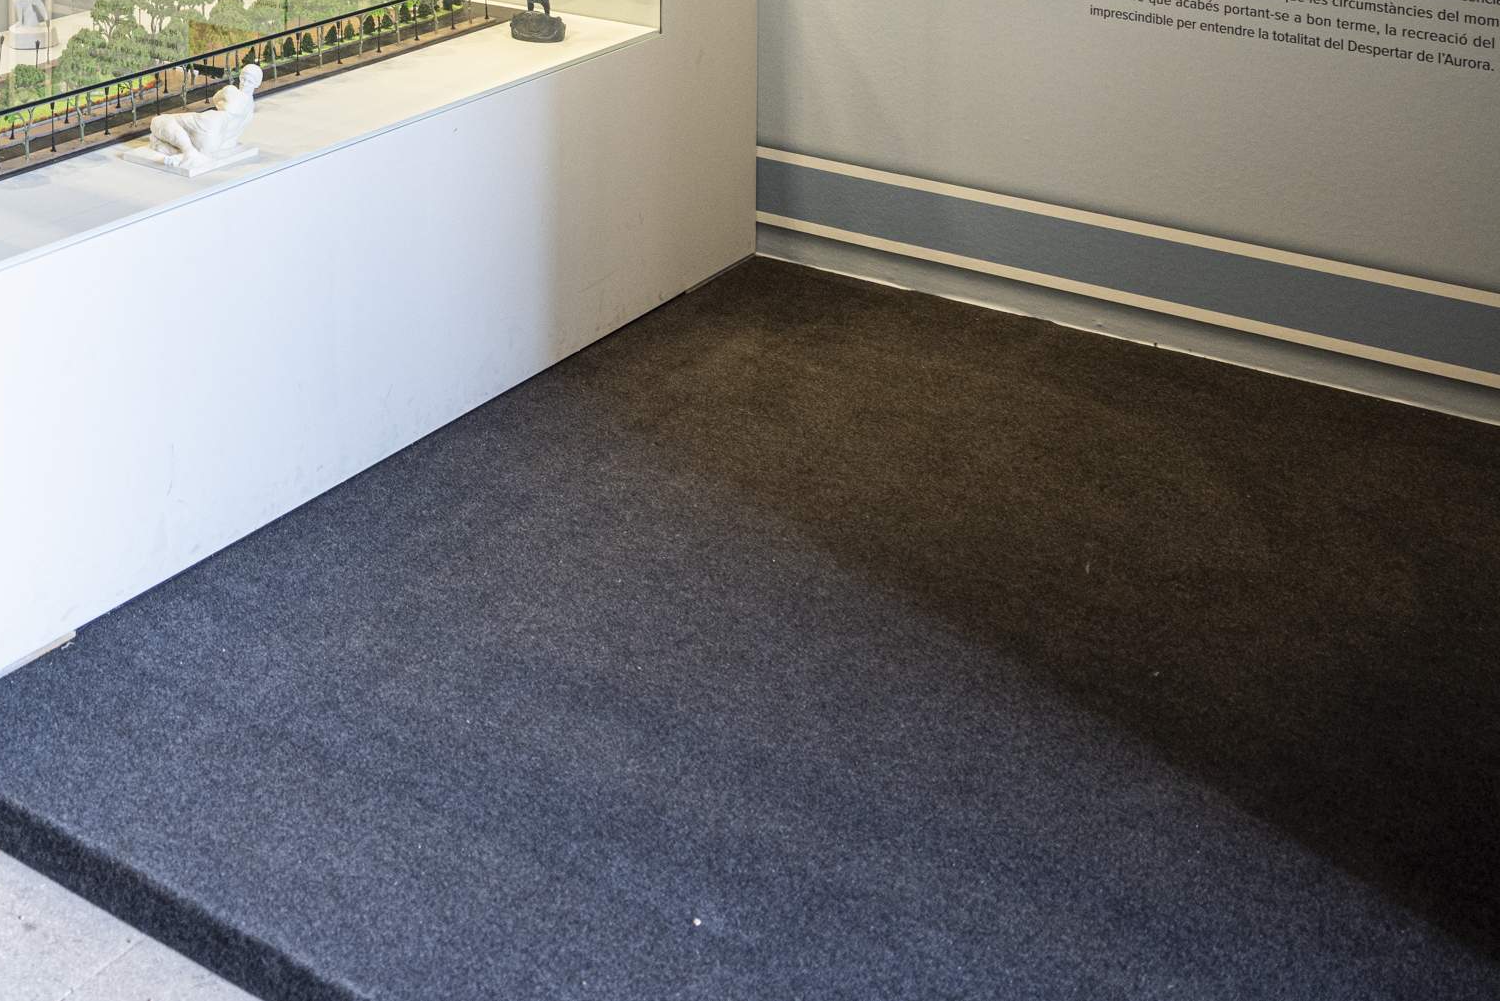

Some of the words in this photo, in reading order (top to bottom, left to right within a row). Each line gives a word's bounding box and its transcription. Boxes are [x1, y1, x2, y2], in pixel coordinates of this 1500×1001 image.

[1090, 4, 1174, 27] imprescindible
[1176, 18, 1197, 30] per
[1199, 22, 1255, 39] entendre
[1258, 27, 1269, 40] la
[1272, 30, 1321, 48] totalitat
[1324, 37, 1344, 50] del
[1348, 39, 1414, 60] Despertar
[1416, 49, 1434, 63] de
